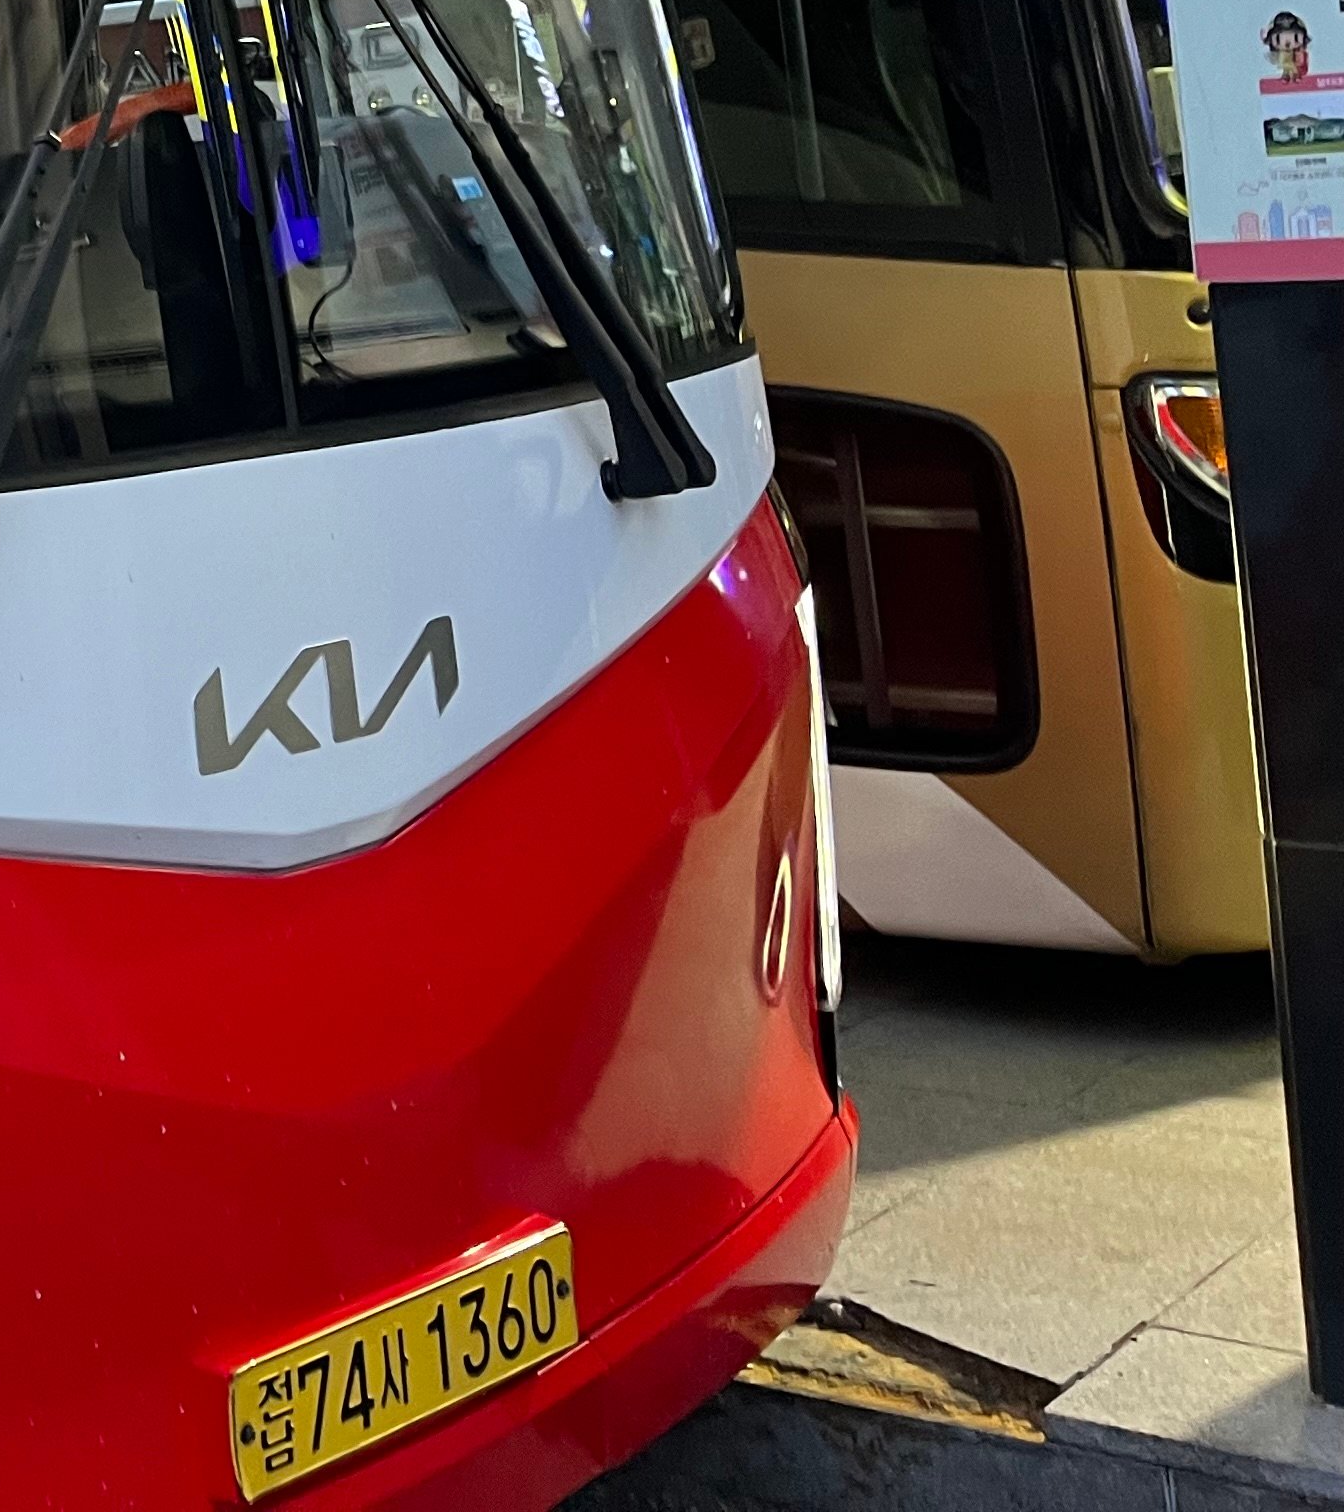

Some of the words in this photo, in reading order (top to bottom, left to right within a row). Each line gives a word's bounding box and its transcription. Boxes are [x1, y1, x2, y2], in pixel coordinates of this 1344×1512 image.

[193, 615, 459, 776] KIA
[298, 1327, 411, 1455] 74사
[427, 1258, 558, 1393] 1360
